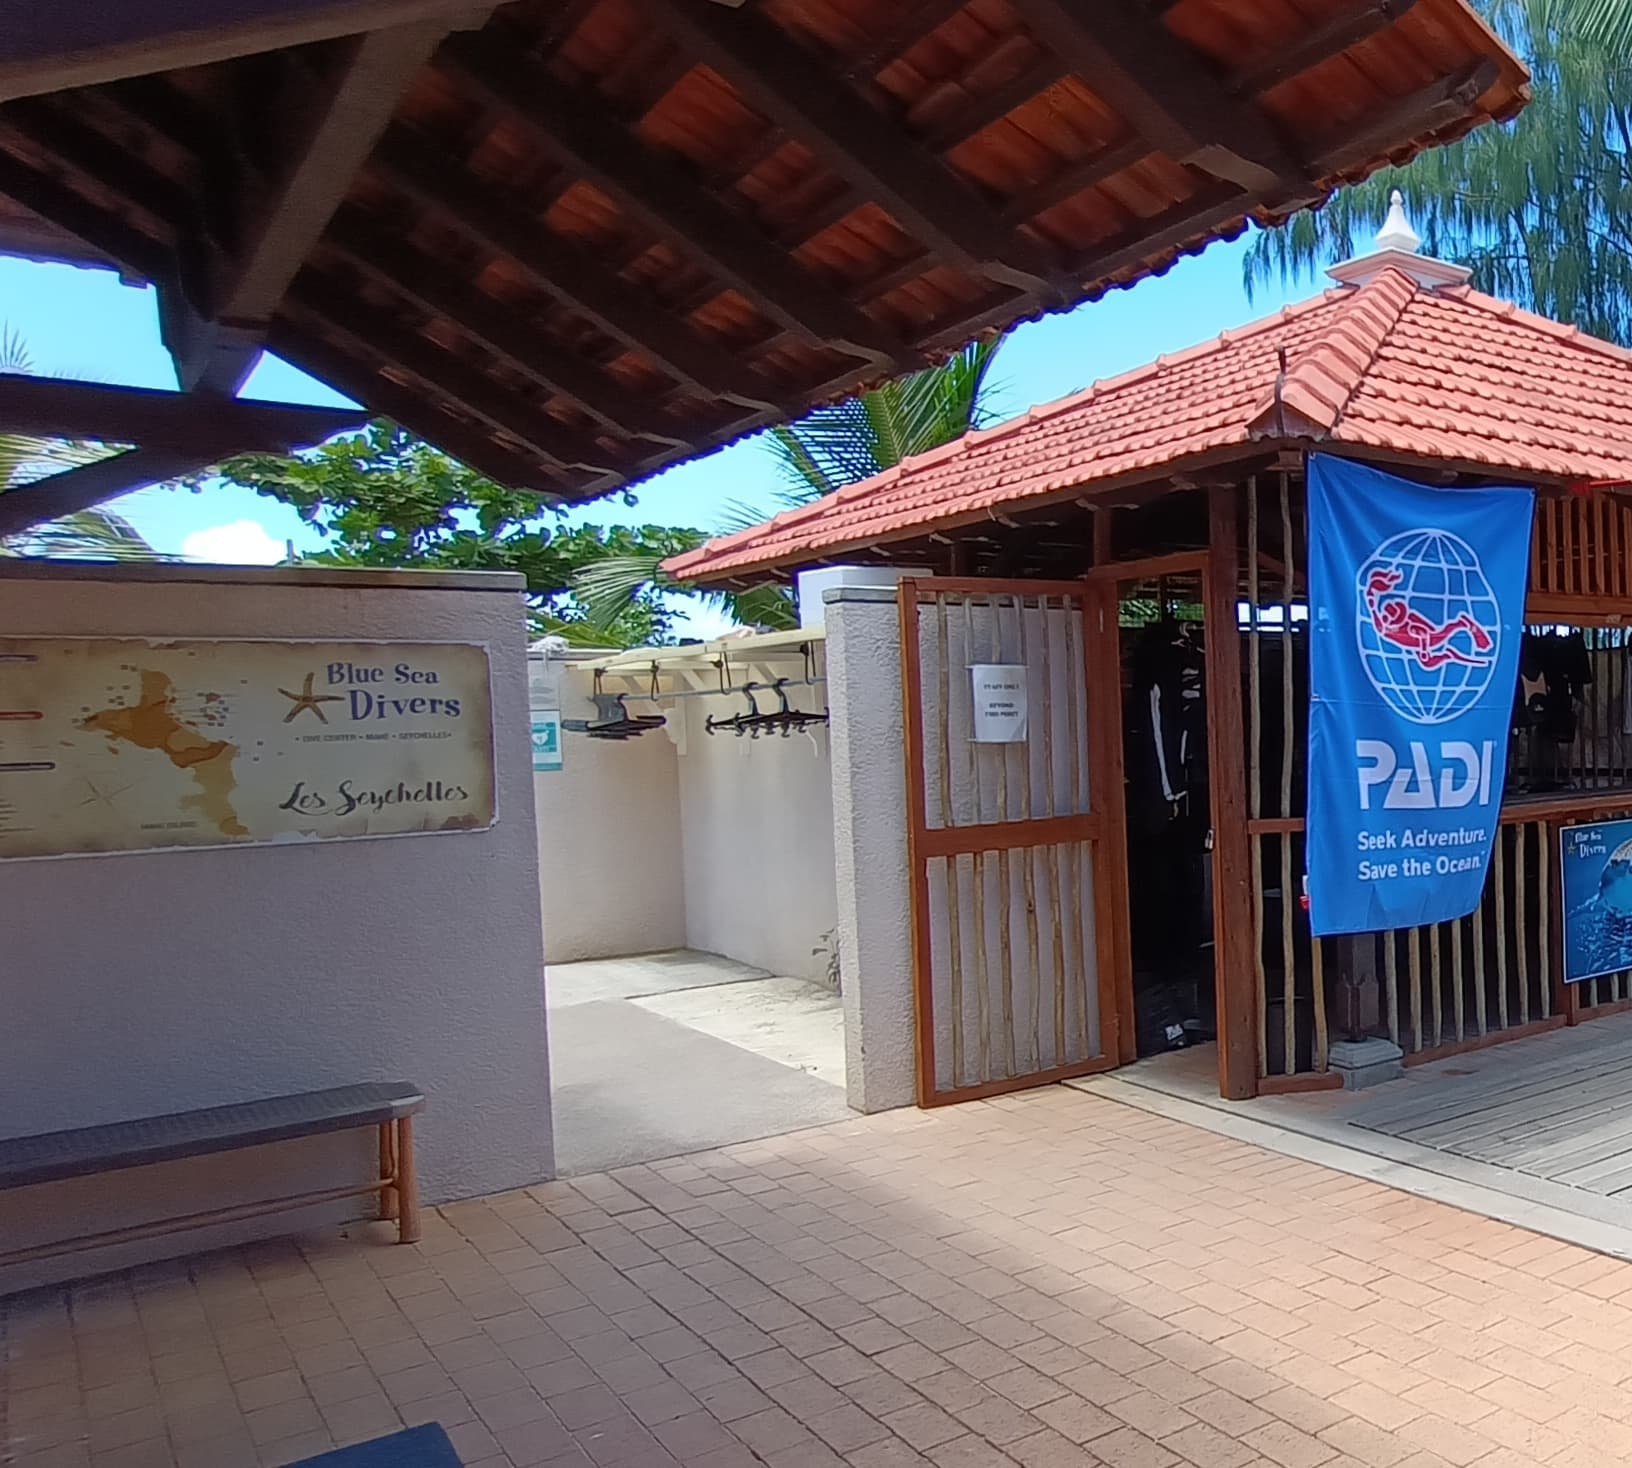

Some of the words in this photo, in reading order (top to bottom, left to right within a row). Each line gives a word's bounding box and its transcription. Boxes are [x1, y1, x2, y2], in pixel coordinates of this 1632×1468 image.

[327, 662, 384, 685] Blue
[394, 664, 439, 684] Sea
[348, 689, 461, 721] Divers
[1356, 739, 1493, 810] PADI
[279, 782, 331, 816] Les
[335, 779, 469, 816] Seychelles
[1357, 830, 1397, 850] Seek
[1400, 827, 1487, 848] Adventure.
[1358, 861, 1398, 881] Save
[1402, 858, 1431, 877] the
[1436, 855, 1482, 875] Ocean.
